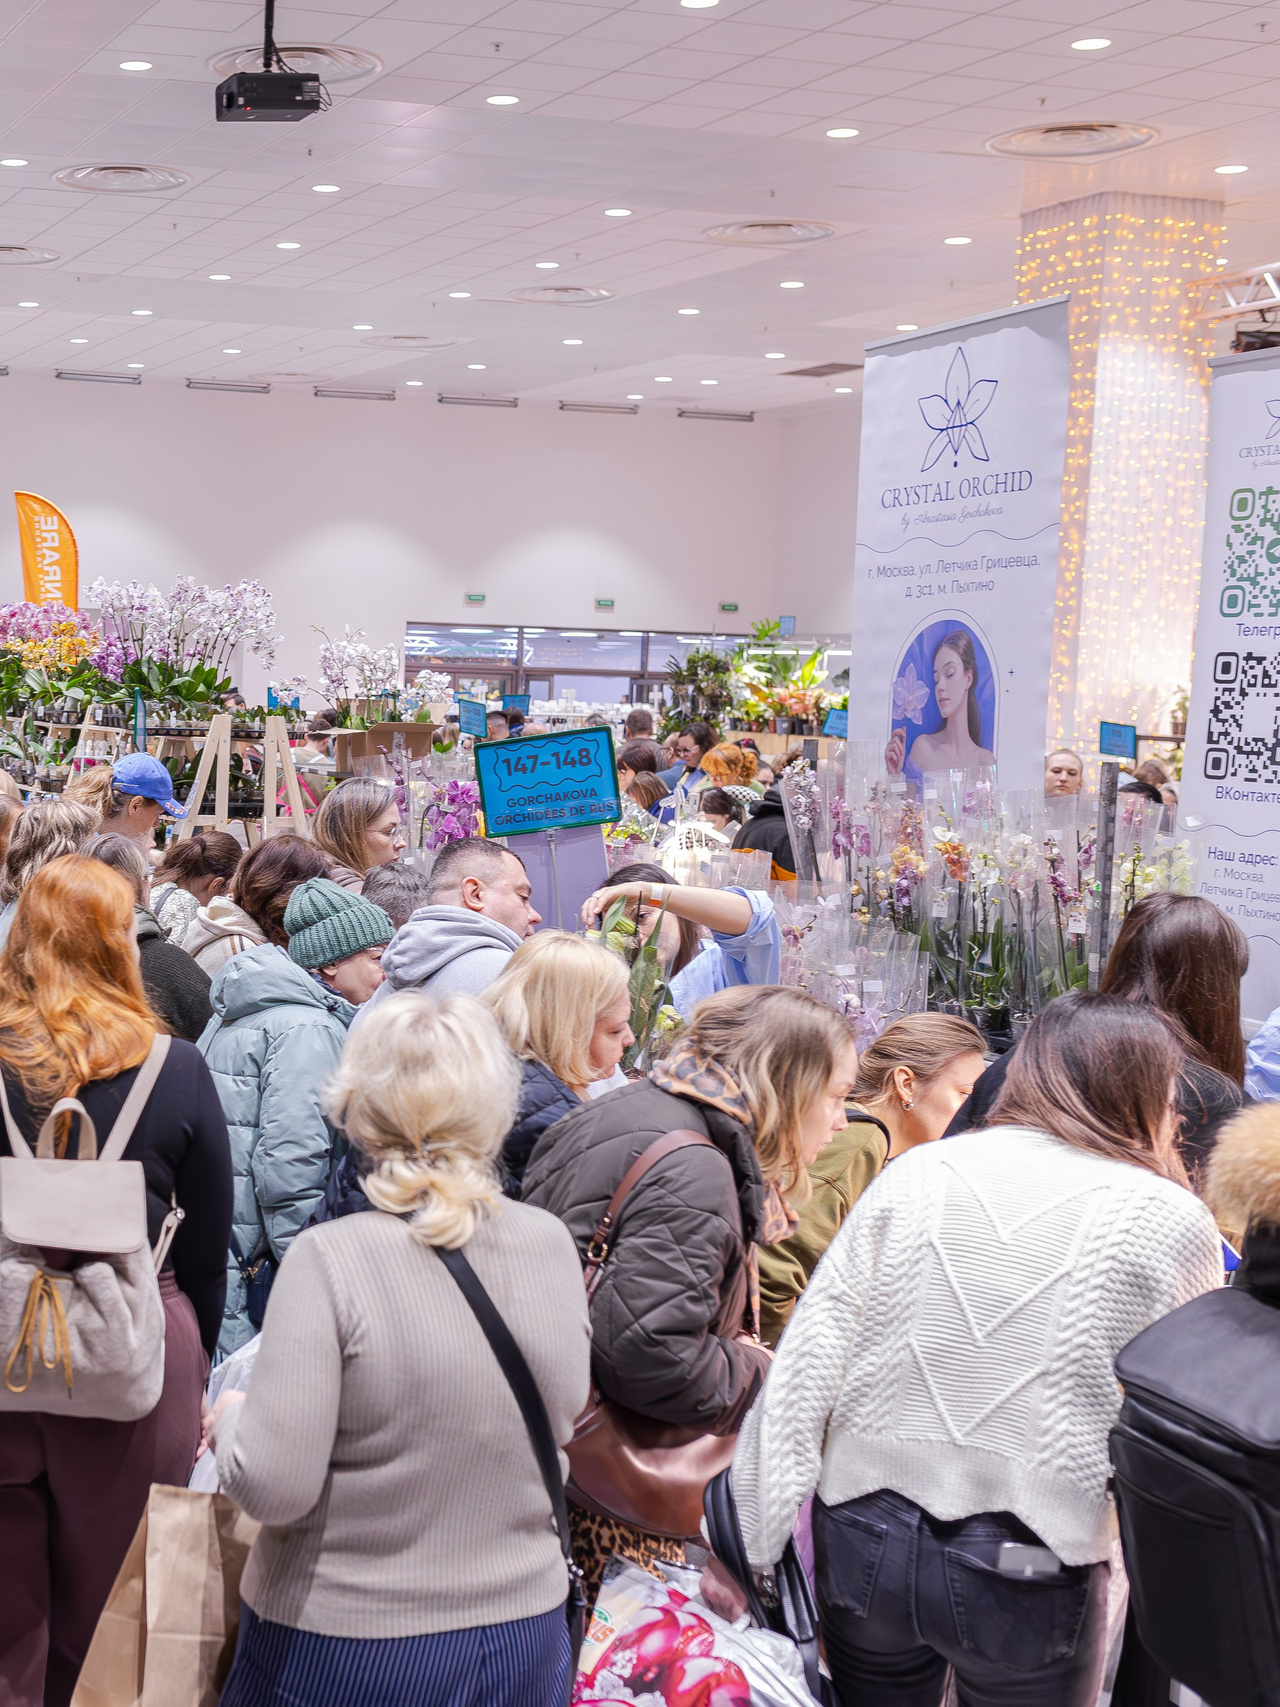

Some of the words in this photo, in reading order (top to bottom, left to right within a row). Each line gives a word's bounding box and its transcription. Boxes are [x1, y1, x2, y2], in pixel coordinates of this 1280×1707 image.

[880, 480, 956, 510] CRYSTAL
[959, 469, 1033, 500] ORCHID
[935, 559, 978, 575] Летчика
[980, 554, 1041, 573] Грицевца,
[950, 579, 995, 595] Пыхтино
[501, 747, 593, 777] 147-148
[506, 787, 599, 808] GORCHAKOVA
[494, 807, 567, 826] ORCHIDÉES
[569, 804, 587, 817] DE
[589, 801, 615, 814] RUS
[1207, 846, 1236, 862] Наш
[1238, 852, 1279, 868] адрес:
[1223, 867, 1266, 884] Москва,
[1199, 882, 1243, 898] Летчика
[1237, 904, 1280, 922] Пыхтино
